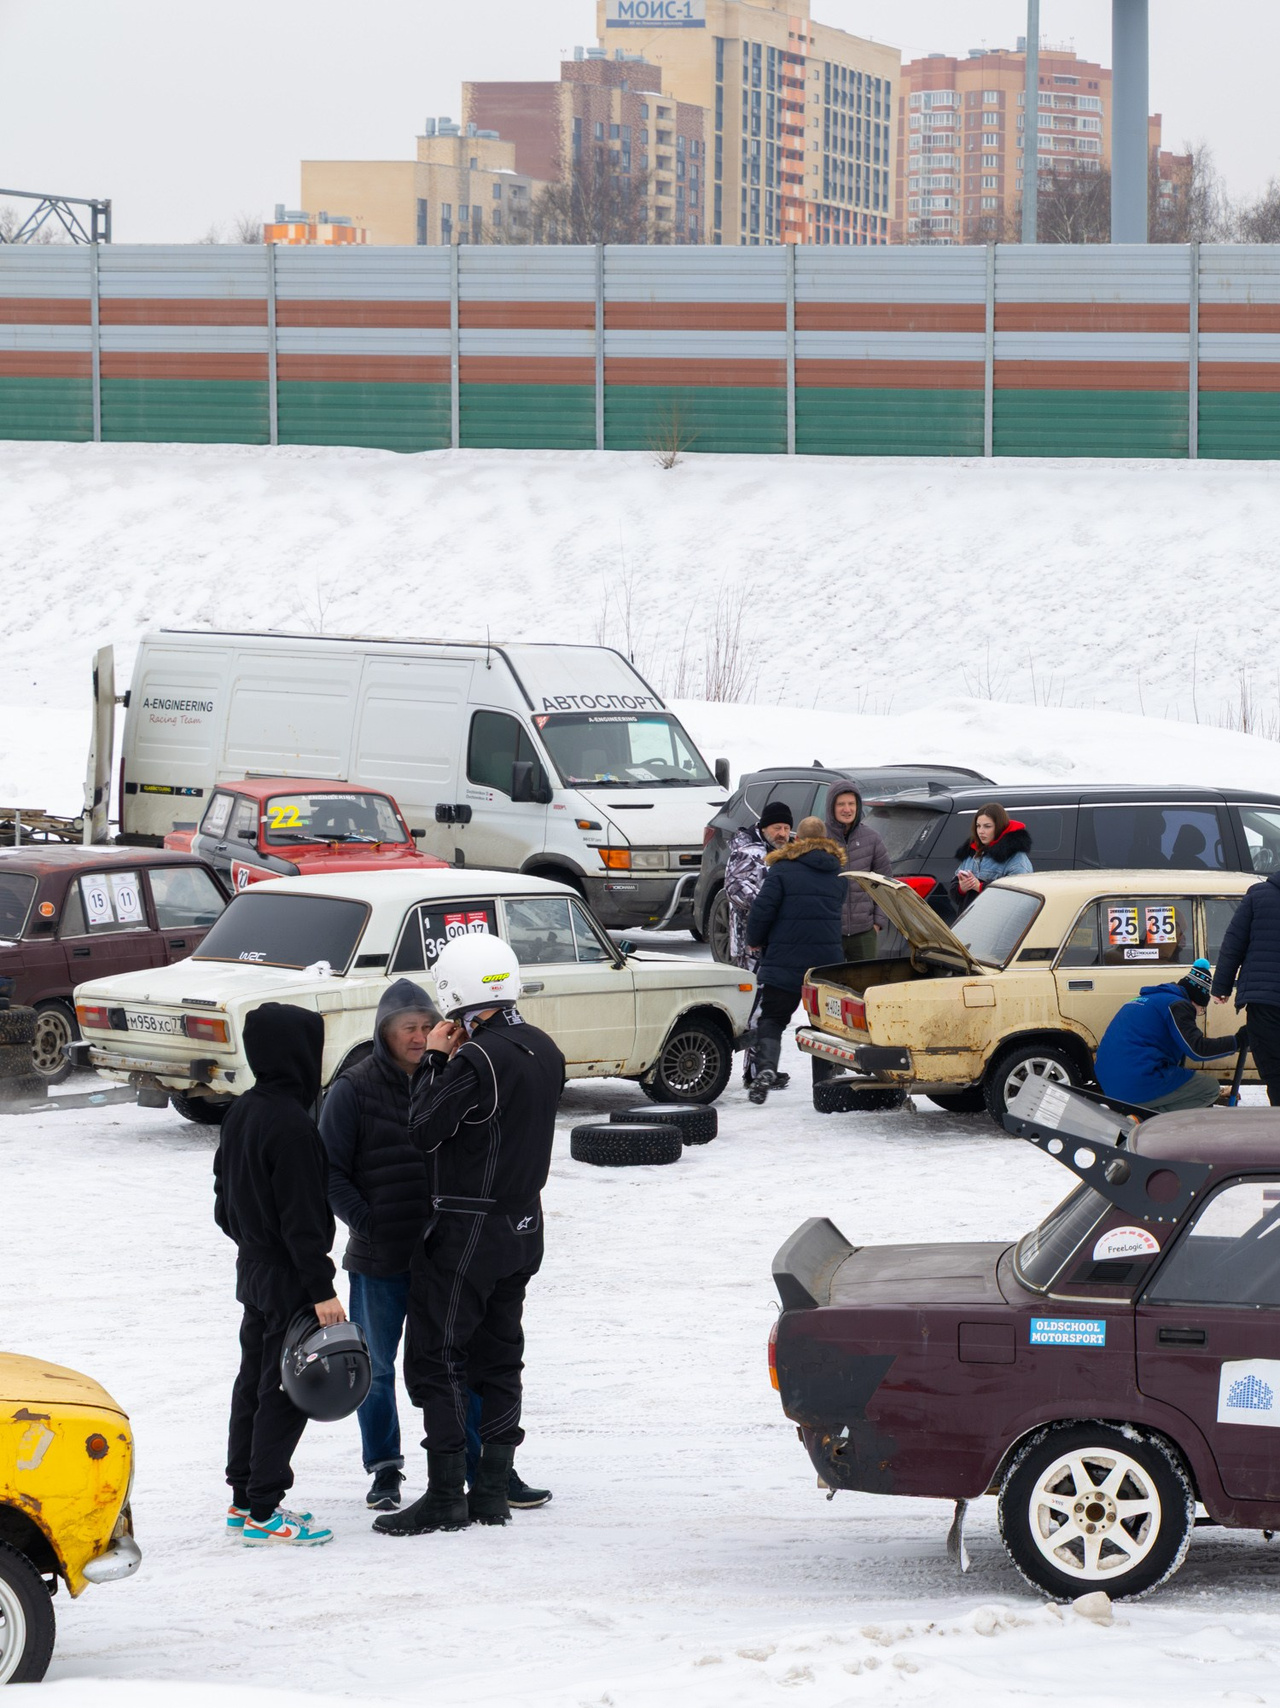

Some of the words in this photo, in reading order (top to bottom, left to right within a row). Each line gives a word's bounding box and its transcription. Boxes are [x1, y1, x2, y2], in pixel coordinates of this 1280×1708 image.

[618, 1, 693, 18] МОИС-1
[143, 698, 213, 712] A-ENGINEERING
[542, 695, 658, 711] АВТОСПОРТ
[149, 714, 178, 726] Racing
[180, 714, 202, 724] Team
[268, 805, 302, 828] 22
[91, 893, 103, 908] 15
[121, 892, 132, 906] 11
[448, 925, 465, 938] 00
[1110, 916, 1137, 936] 25
[1147, 915, 1174, 934] 35
[239, 951, 267, 961] WRC
[130, 1015, 171, 1032] М958ХС
[1107, 1242, 1143, 1253] FreeLogic
[1036, 1321, 1100, 1332] OLDSCHOOL
[1031, 1332, 1104, 1344] MOTORSPORT
